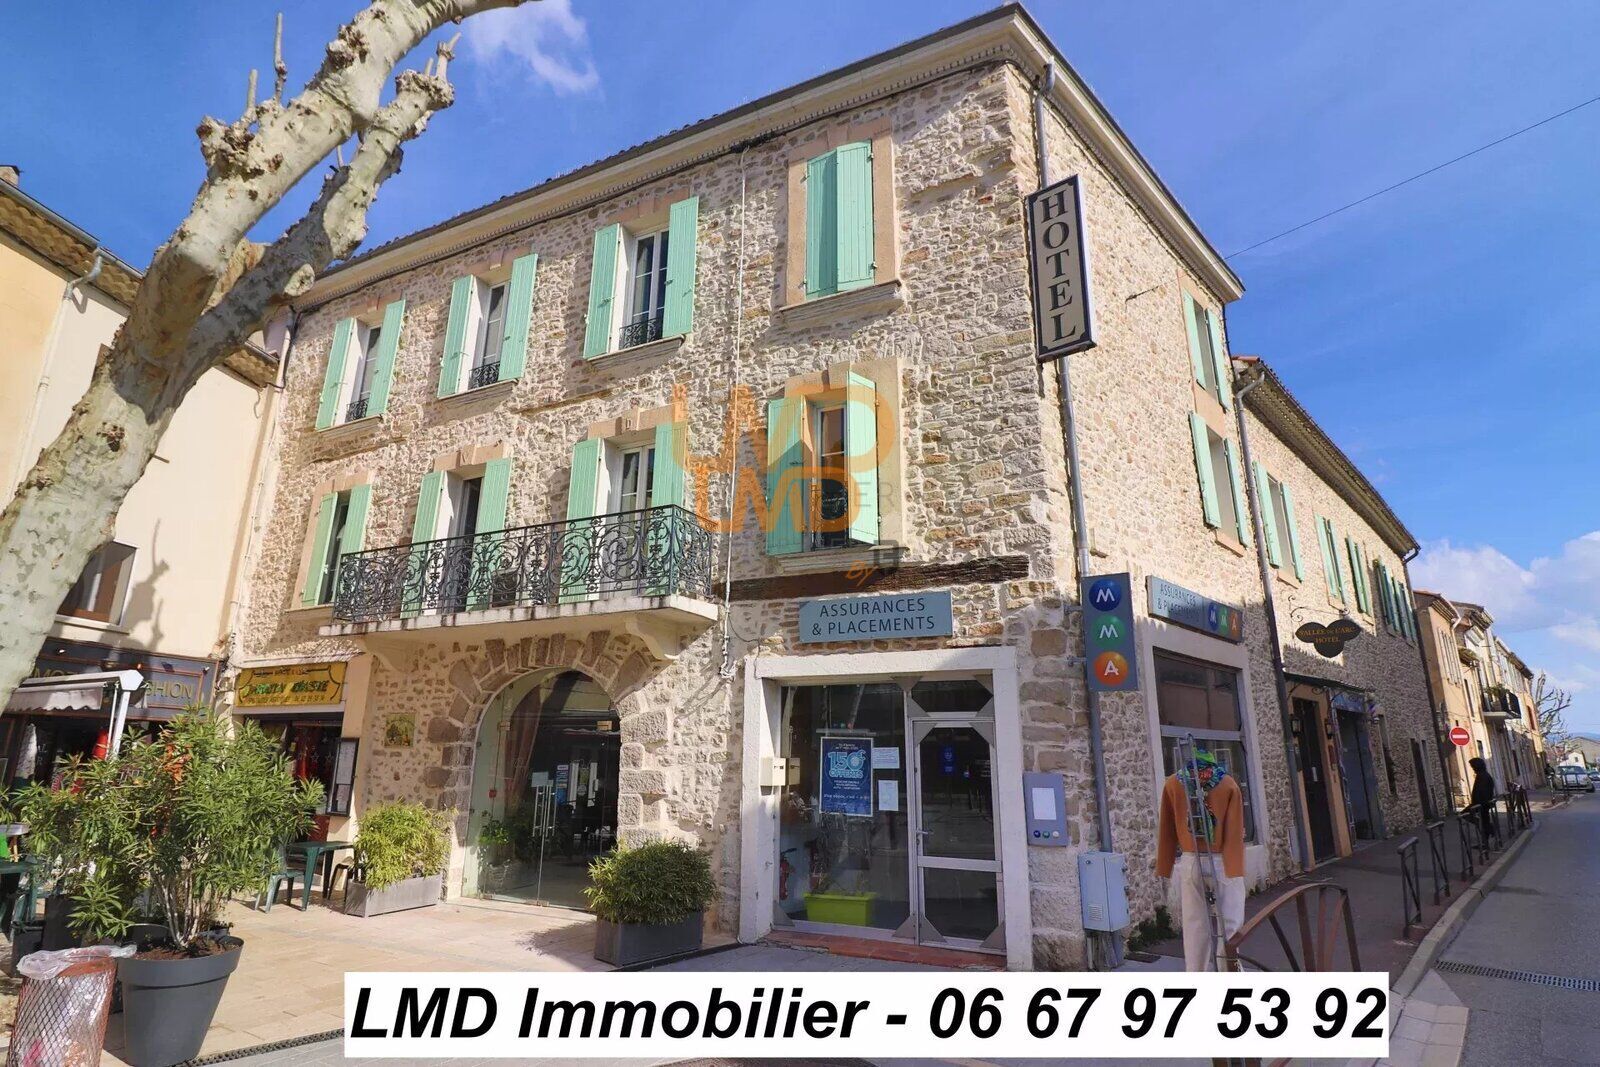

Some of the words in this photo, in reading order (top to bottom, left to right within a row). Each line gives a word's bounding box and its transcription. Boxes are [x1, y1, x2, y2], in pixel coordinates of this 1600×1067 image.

[1040, 189, 1077, 343] HOTEL
[819, 598, 926, 618] ASSURANCES
[811, 623, 822, 636] &
[828, 616, 935, 635] PLACEMENTS
